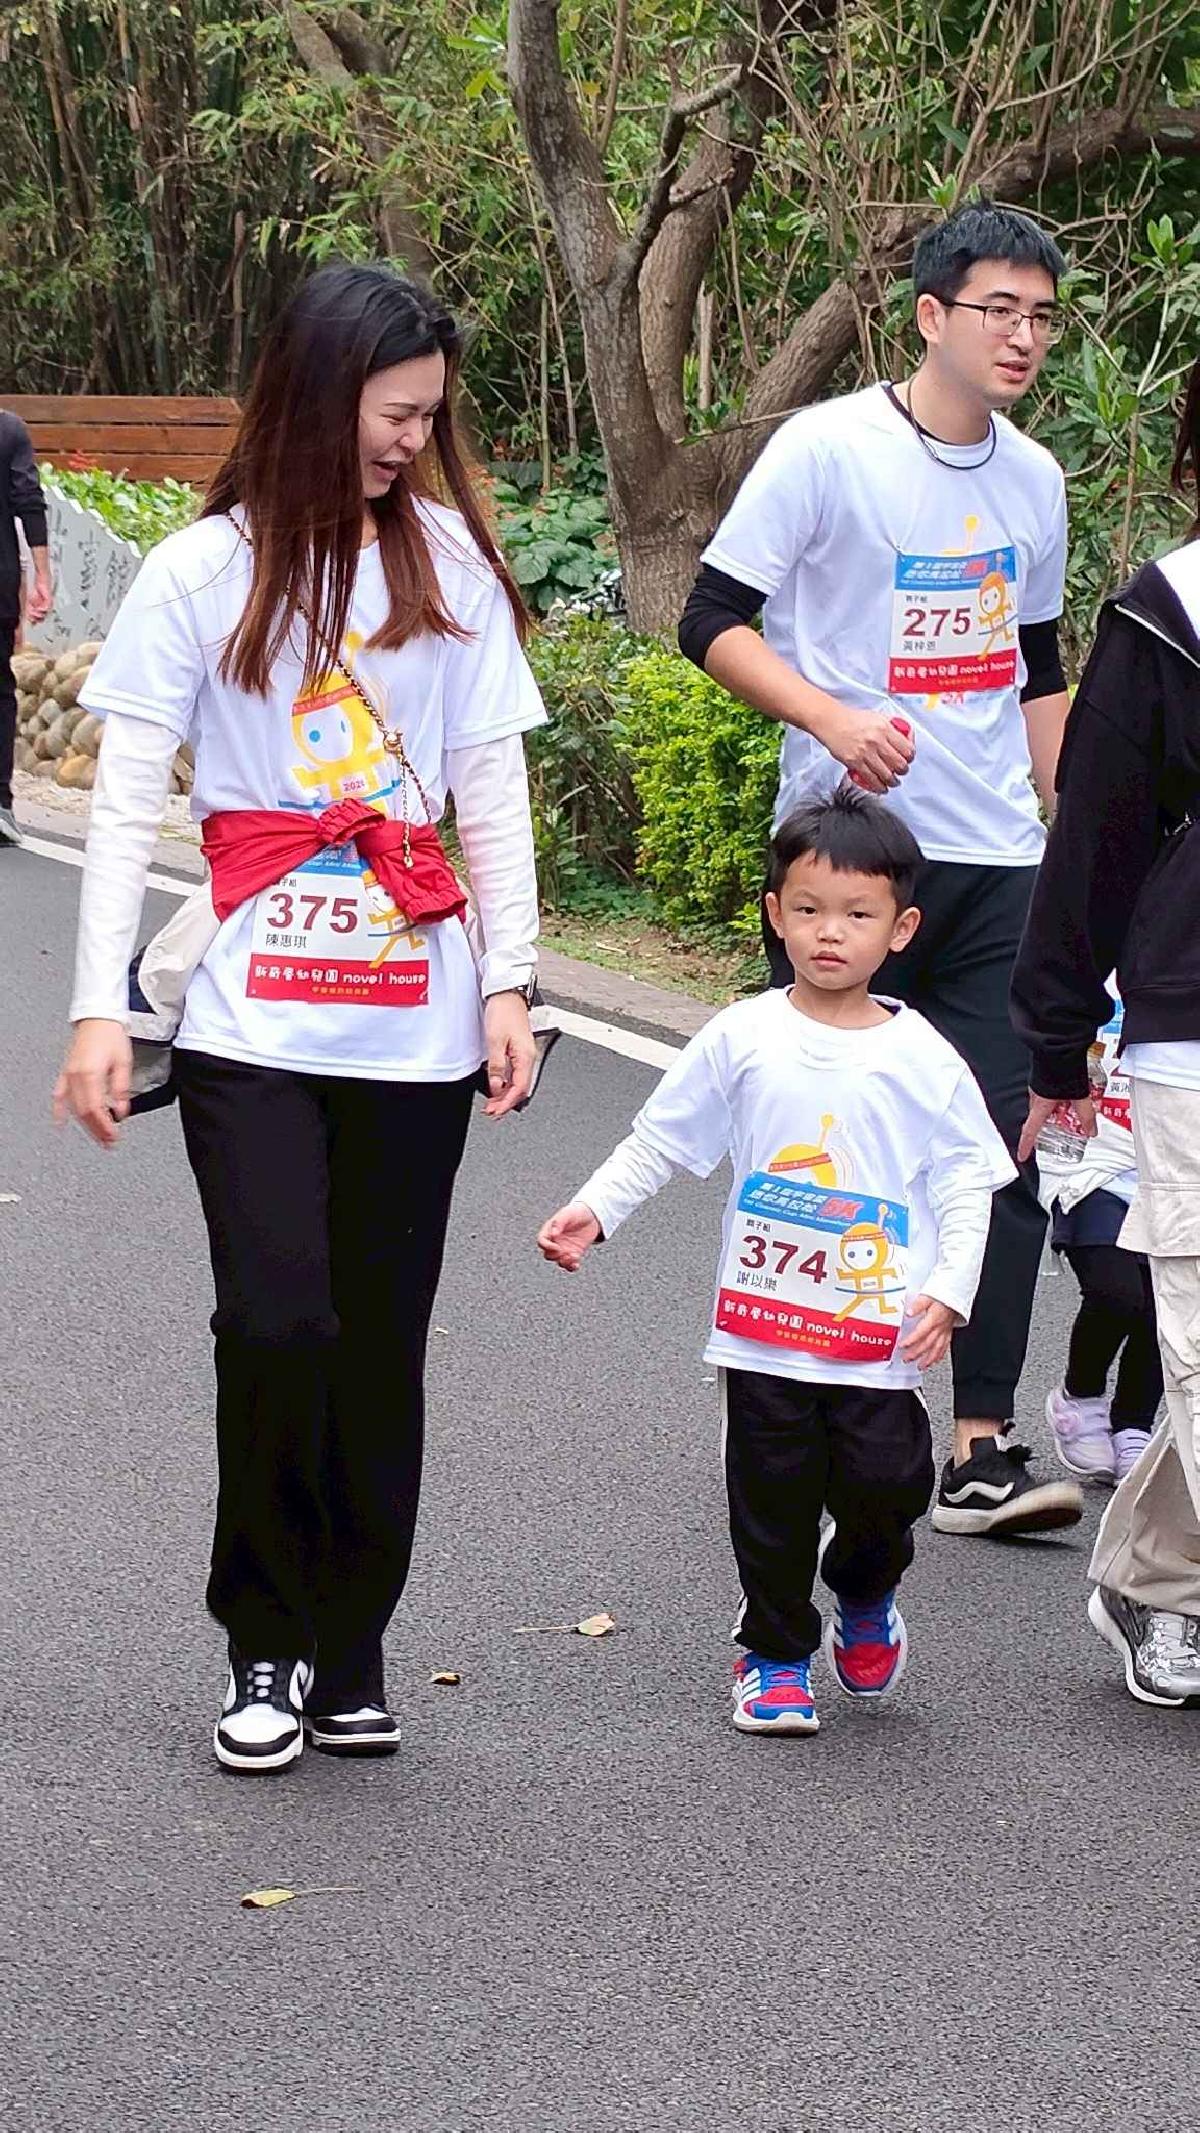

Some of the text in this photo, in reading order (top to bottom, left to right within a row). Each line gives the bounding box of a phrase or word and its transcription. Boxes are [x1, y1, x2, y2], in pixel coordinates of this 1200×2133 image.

[903, 608, 971, 637] 275
[267, 893, 358, 934] 375
[343, 972, 384, 985] novel
[389, 972, 426, 985] house
[746, 1218, 771, 1233] 親子組
[740, 1235, 828, 1285] 374
[806, 1322, 845, 1340] novel
[850, 1331, 893, 1346] house
